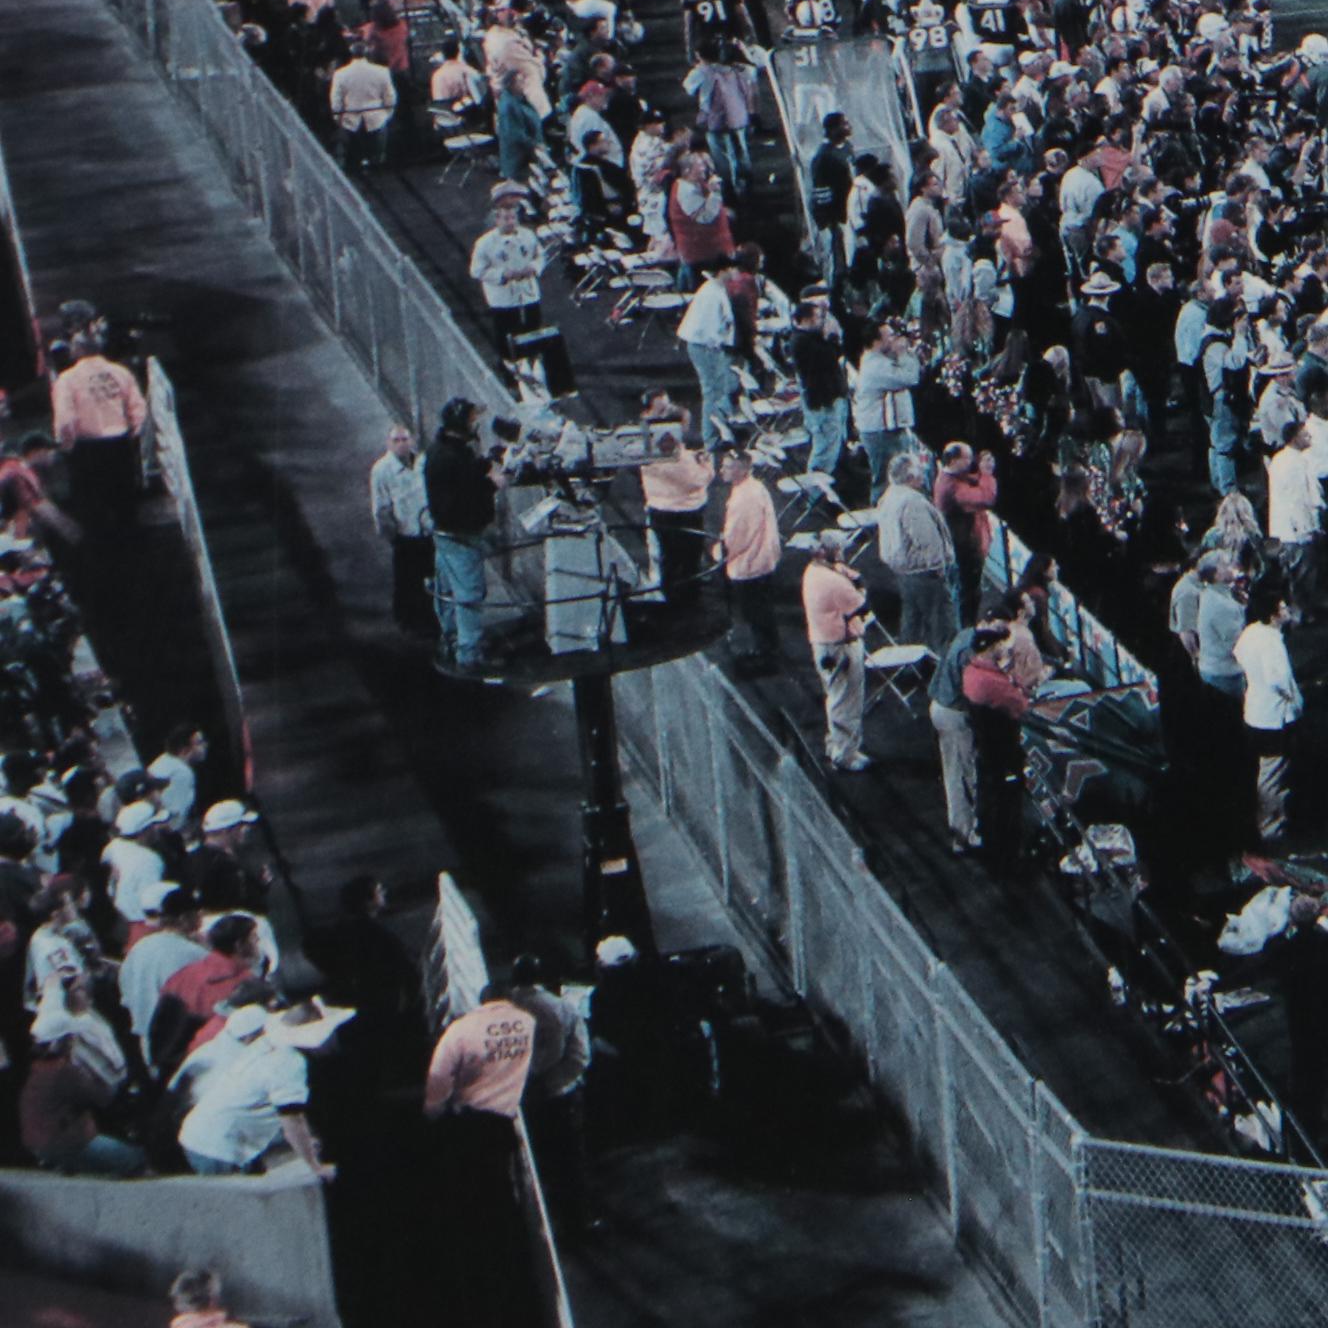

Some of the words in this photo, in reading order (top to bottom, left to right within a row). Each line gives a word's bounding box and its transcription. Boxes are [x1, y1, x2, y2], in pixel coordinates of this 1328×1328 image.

[697, 0, 728, 24] 91
[910, 26, 948, 51] 98
[486, 1021, 525, 1037] CSC
